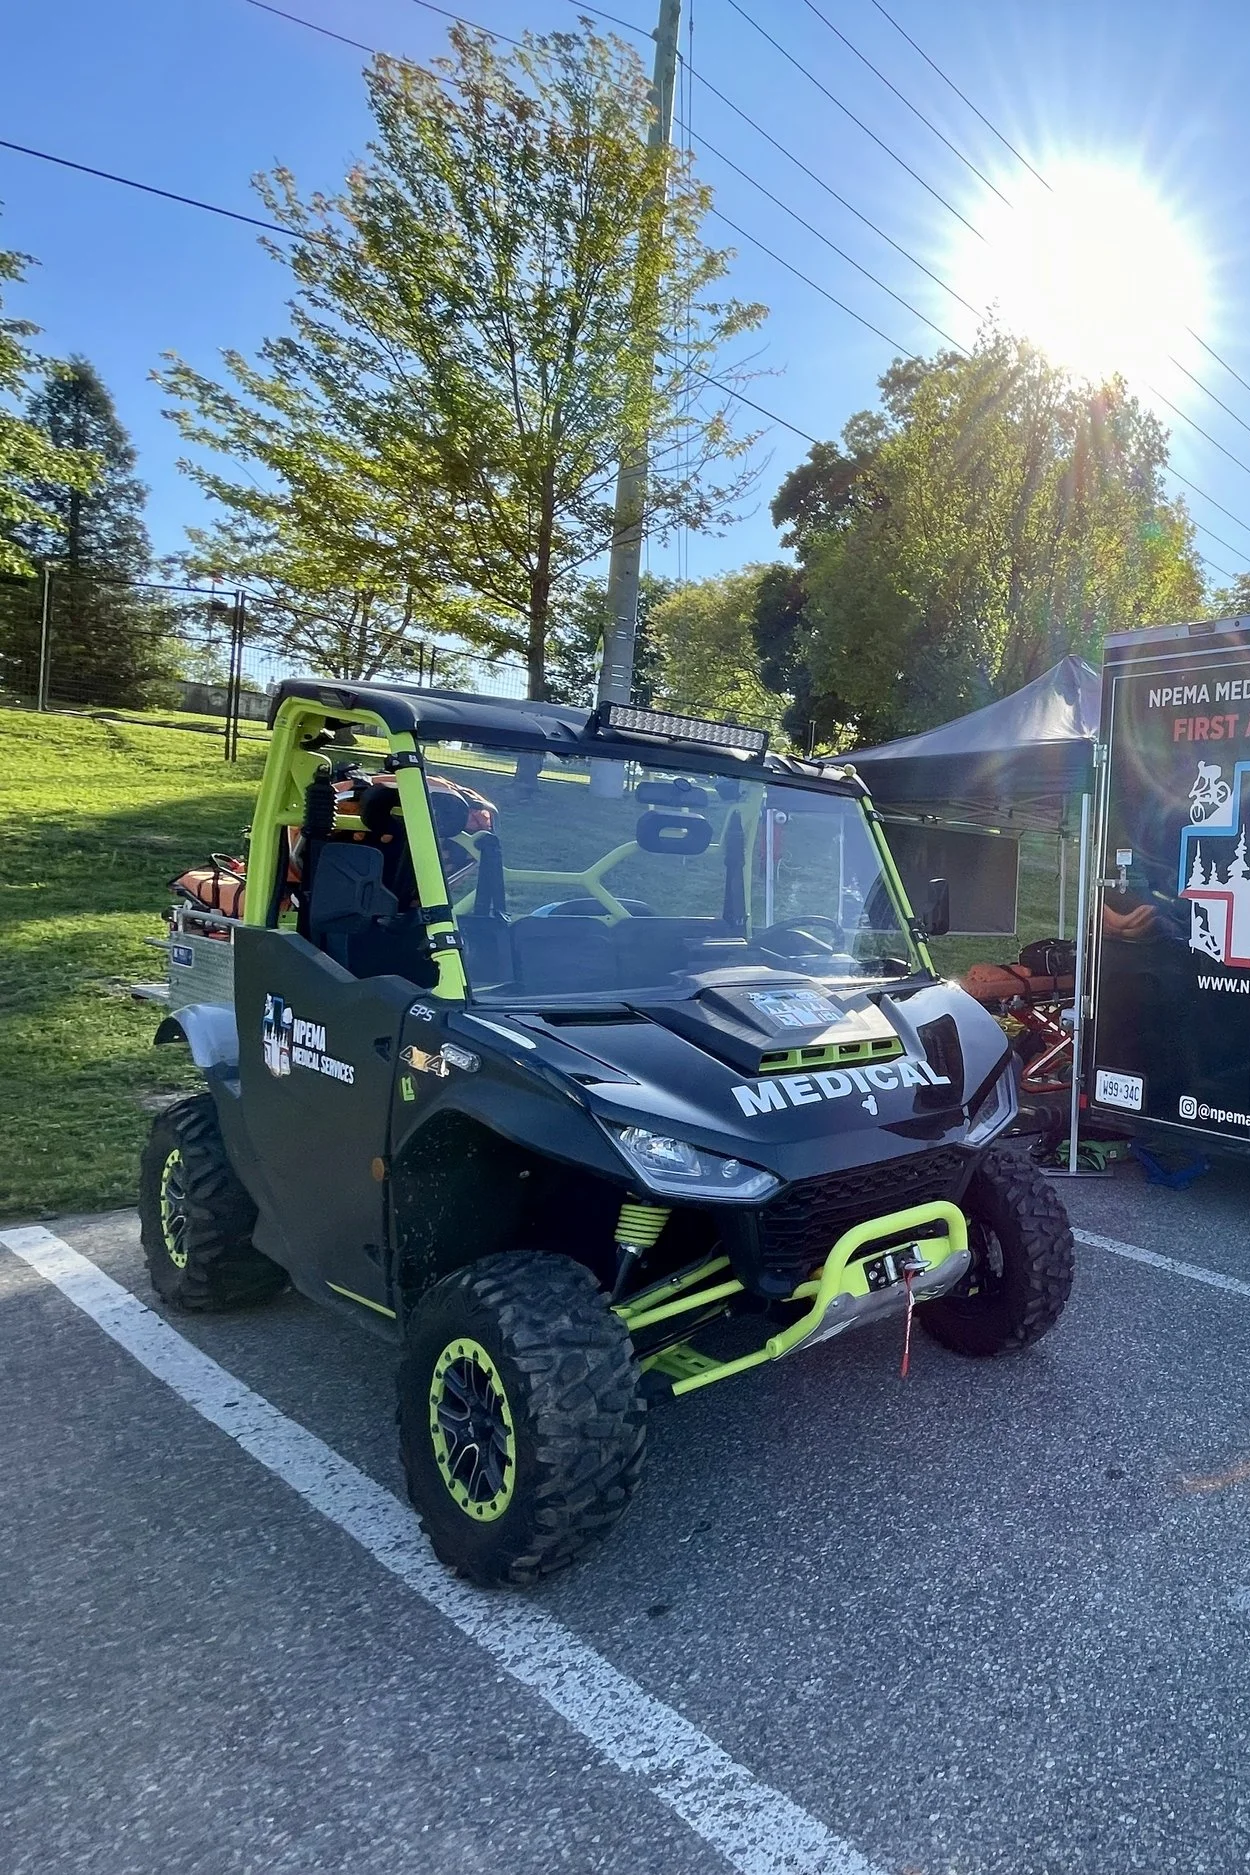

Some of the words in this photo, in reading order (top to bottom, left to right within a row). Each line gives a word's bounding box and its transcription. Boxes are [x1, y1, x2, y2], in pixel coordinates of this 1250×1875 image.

[1148, 683, 1210, 708] NPEMA
[1173, 713, 1240, 742] FIRST
[409, 1003, 436, 1022] EPS
[293, 1018, 326, 1052] NPEMA
[292, 1045, 320, 1071] MEDICAL
[320, 1055, 355, 1084] SERVICES
[730, 1060, 952, 1118] MEDICAL
